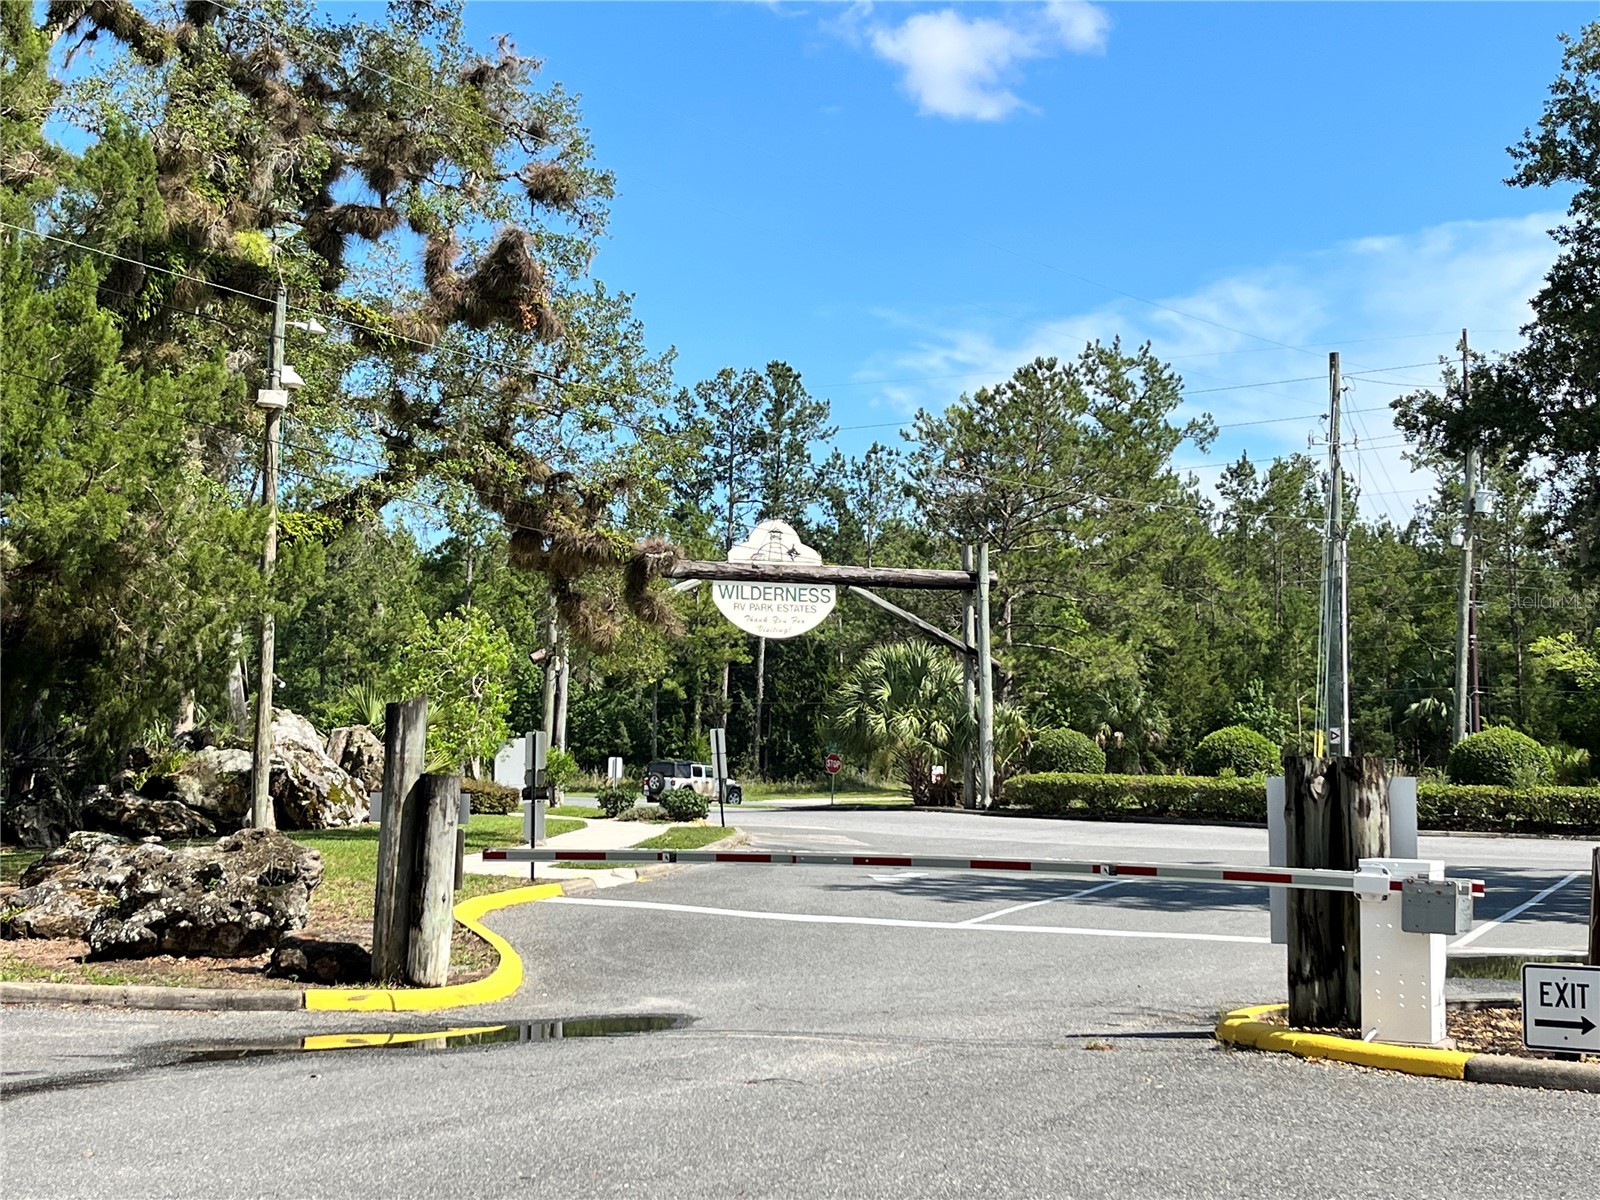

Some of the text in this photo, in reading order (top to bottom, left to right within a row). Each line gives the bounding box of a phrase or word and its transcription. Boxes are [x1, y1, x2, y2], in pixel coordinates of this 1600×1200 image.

[718, 584, 831, 604] WILDERNESS
[733, 602, 817, 614] RV PARK ESTATES
[744, 614, 768, 623] Thank
[756, 625, 792, 635] Visiting!
[826, 759, 841, 768] STOP
[1539, 981, 1590, 1009] EXIT
